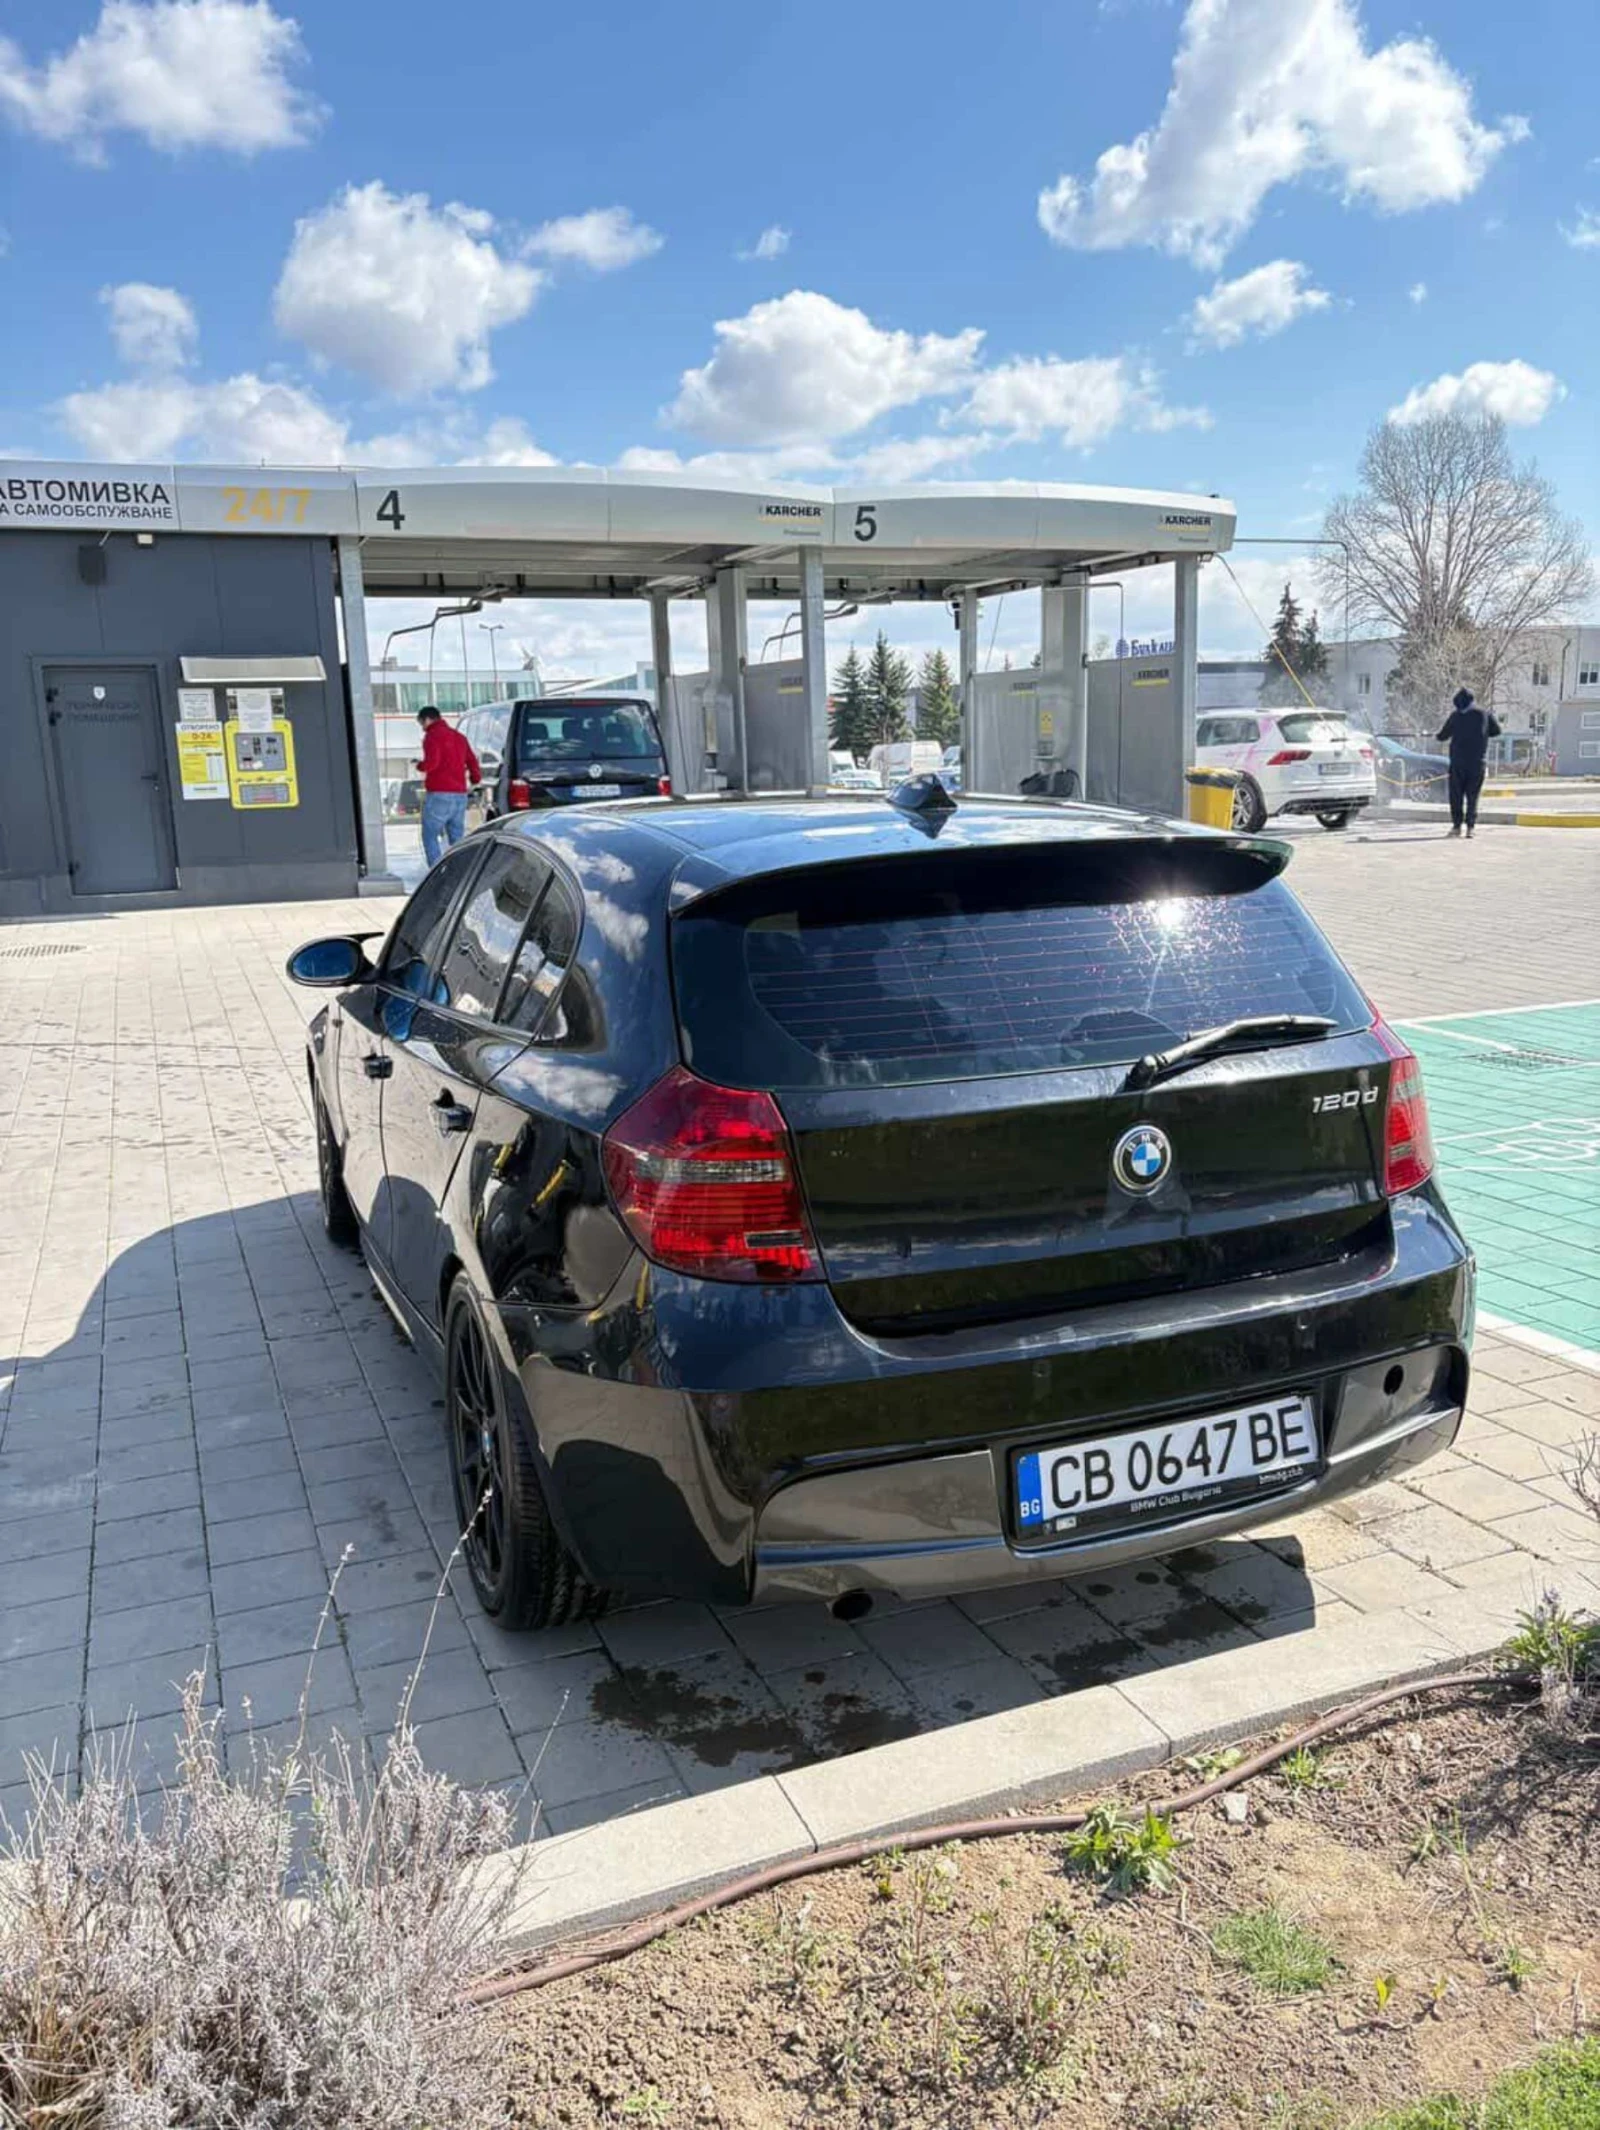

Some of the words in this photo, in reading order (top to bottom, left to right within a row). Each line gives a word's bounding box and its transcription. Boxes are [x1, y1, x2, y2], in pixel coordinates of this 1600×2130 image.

[14, 503, 173, 519] САМООБСЛУЖВАНЕ
[221, 486, 312, 523] 24/7
[376, 490, 405, 530] 4
[854, 505, 877, 542] 5
[1312, 1086, 1379, 1114] 120d
[1050, 1449, 1115, 1510] CB
[1127, 1418, 1238, 1493] 0647
[1248, 1403, 1310, 1466] BE
[1020, 1500, 1041, 1519] BG
[1130, 1499, 1157, 1513] BMW
[1158, 1495, 1181, 1507] Club
